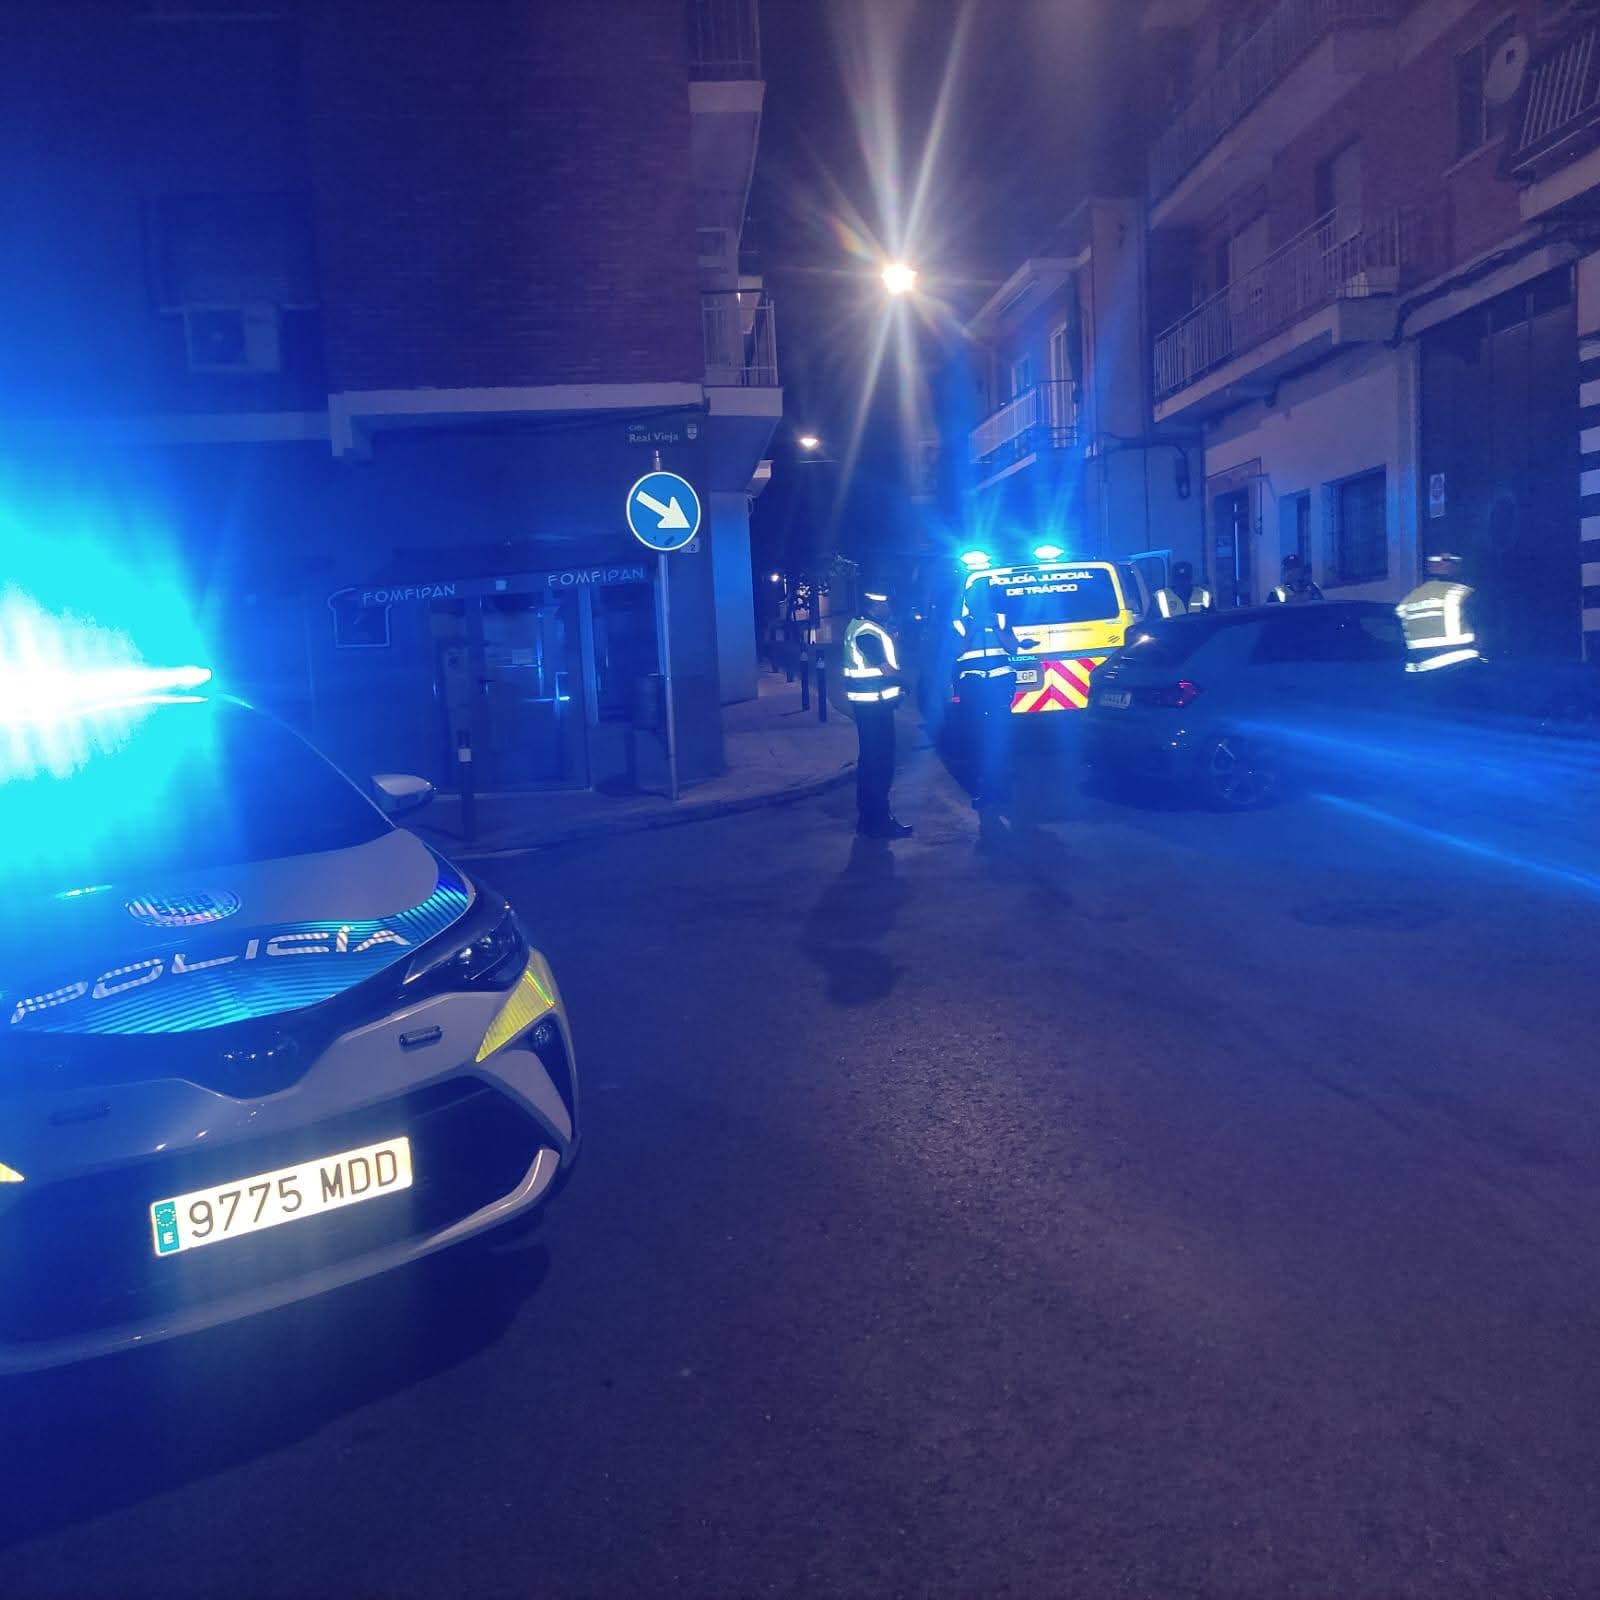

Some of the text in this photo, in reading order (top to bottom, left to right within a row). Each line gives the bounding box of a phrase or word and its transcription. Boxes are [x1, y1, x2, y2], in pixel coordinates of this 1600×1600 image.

[629, 432, 651, 442] Real
[547, 566, 645, 587] FOMFIPAN
[1038, 570, 1094, 582] JUDICIAL
[362, 583, 457, 605] FOMFIPAN
[1006, 588, 1024, 597] DE
[188, 1149, 398, 1238] 9775 MDD
[162, 1230, 175, 1245] E
